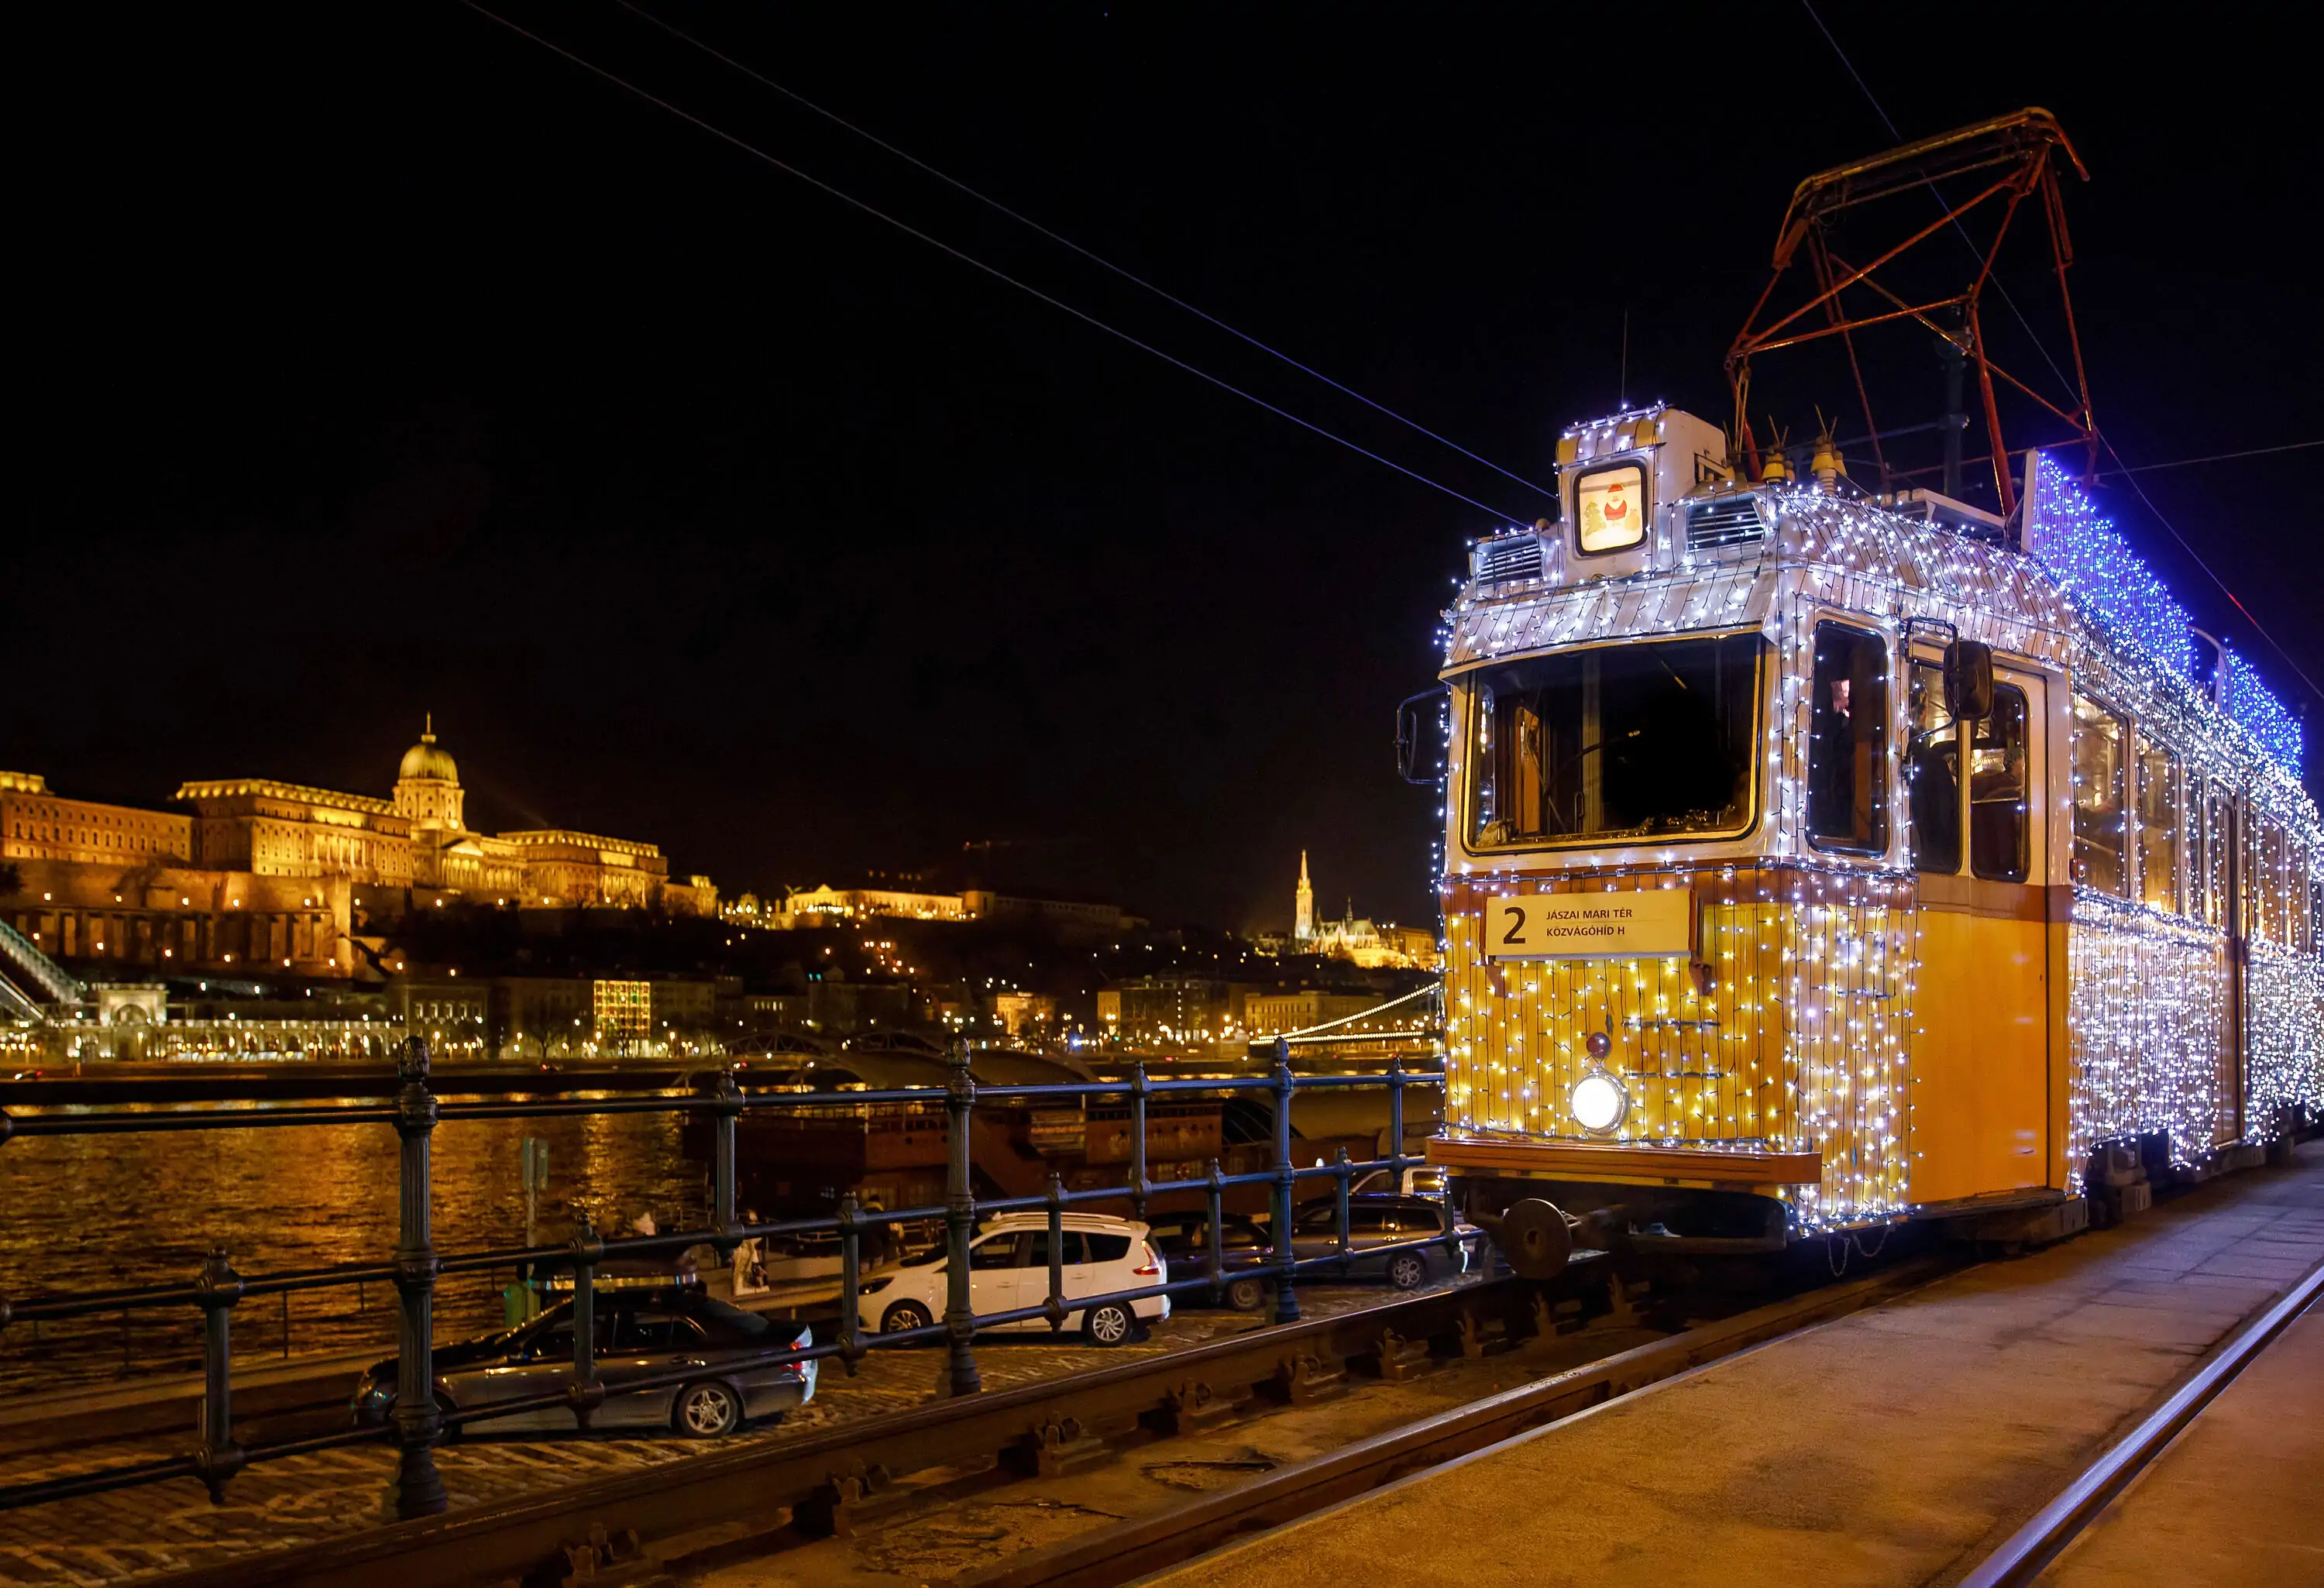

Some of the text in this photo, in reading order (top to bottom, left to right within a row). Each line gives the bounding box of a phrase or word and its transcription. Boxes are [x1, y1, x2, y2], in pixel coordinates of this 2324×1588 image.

[1546, 907, 1632, 920] JÁSZAI MARI TÉR
[1504, 906, 1526, 944] 2
[1546, 925, 1624, 937] KÖZVÁGÓHÍD H
